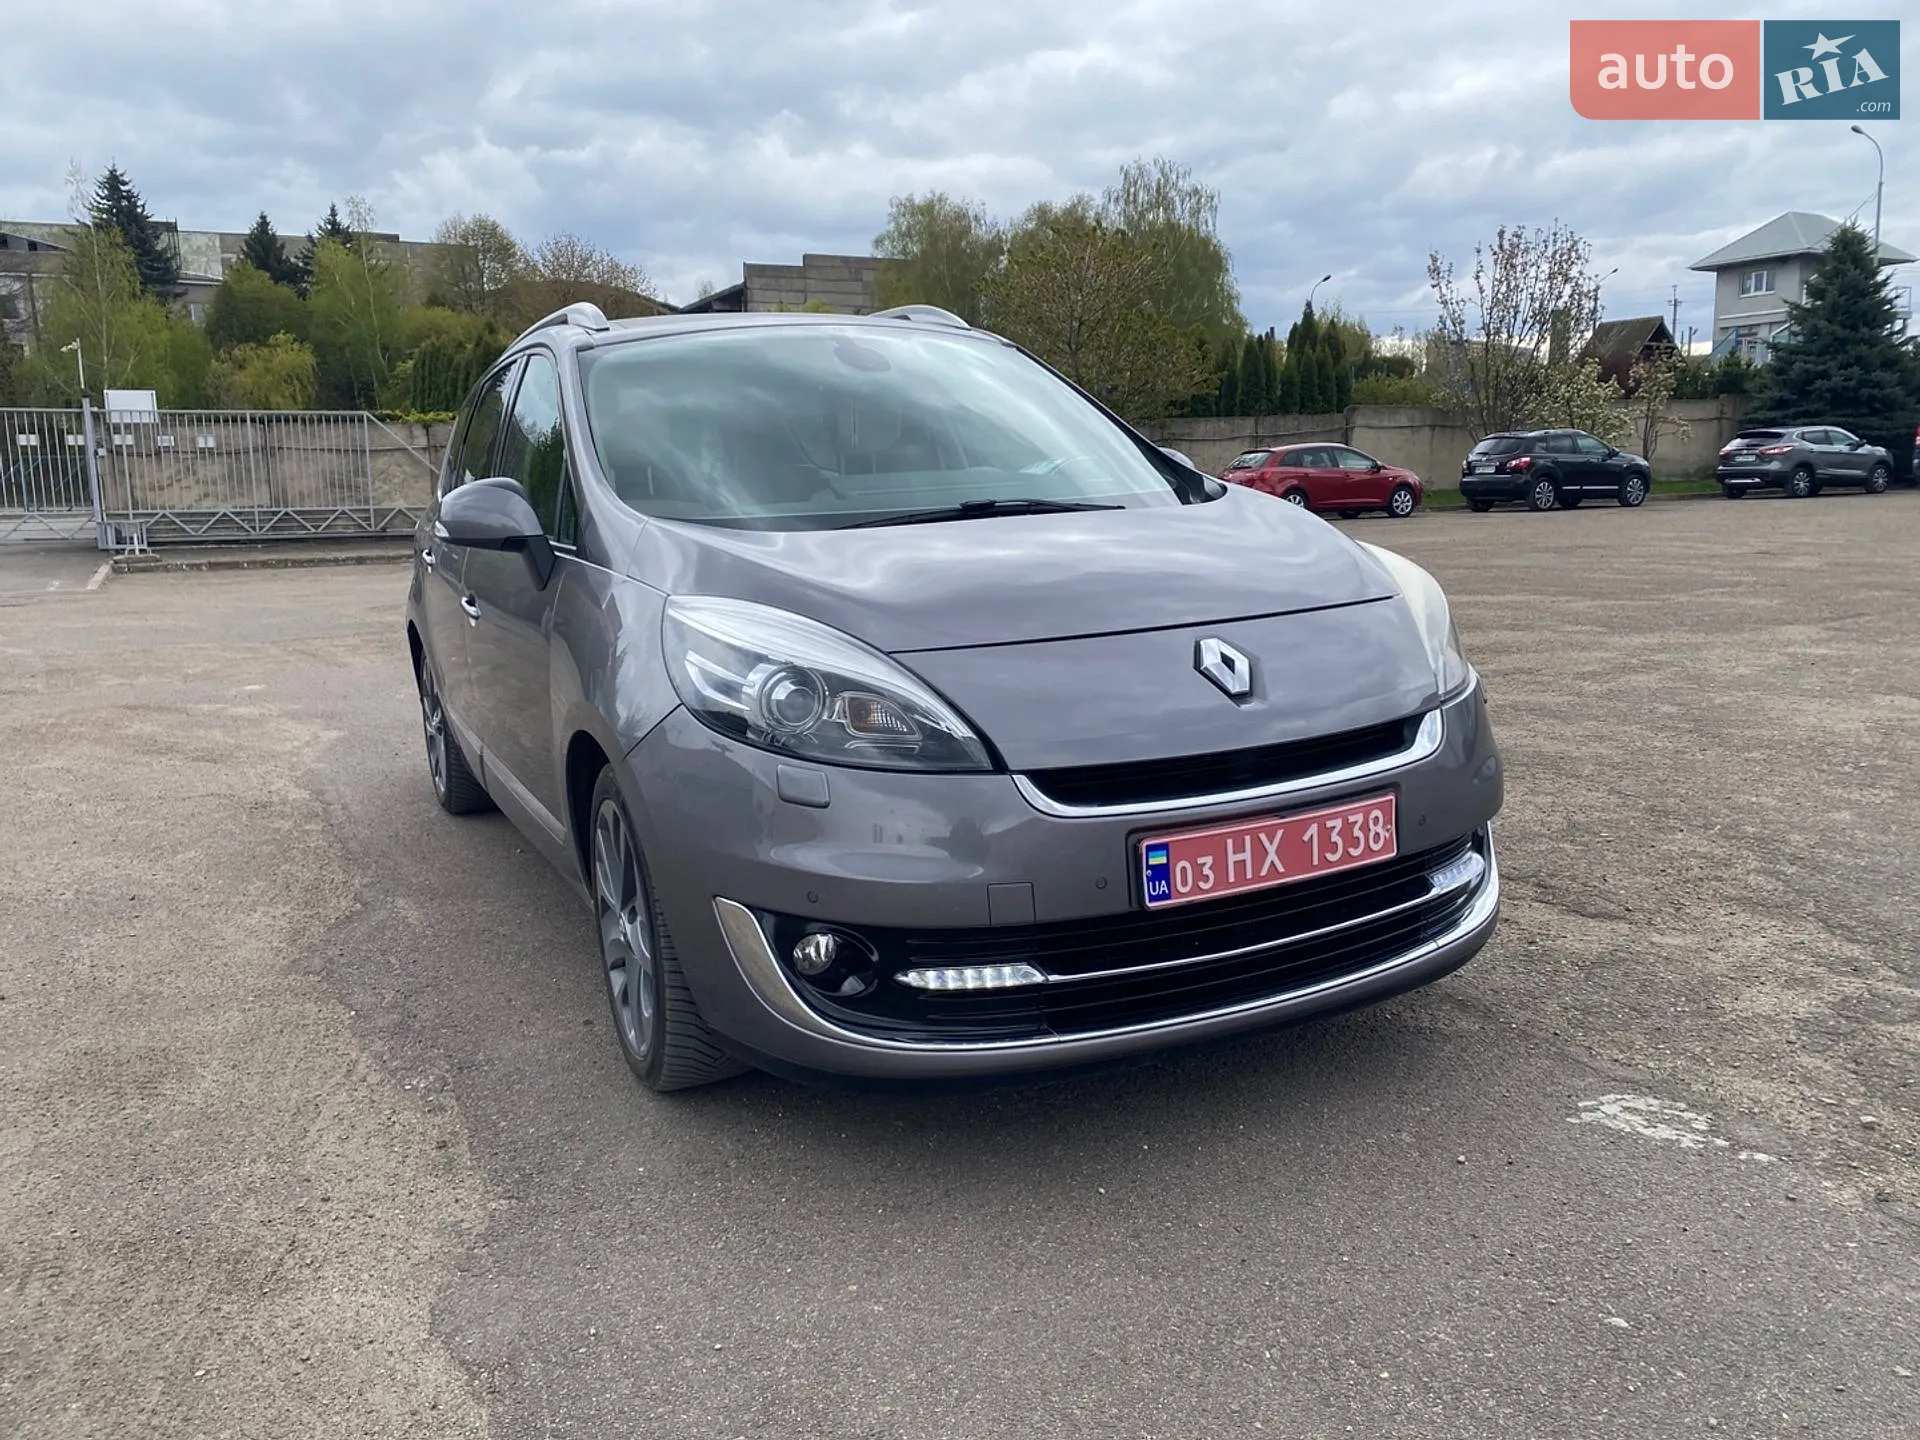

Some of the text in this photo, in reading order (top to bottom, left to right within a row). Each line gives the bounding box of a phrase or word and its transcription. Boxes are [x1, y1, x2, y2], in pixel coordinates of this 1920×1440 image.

[1174, 809, 1385, 894] 03 HX 1338
[1150, 879, 1169, 896] UA
